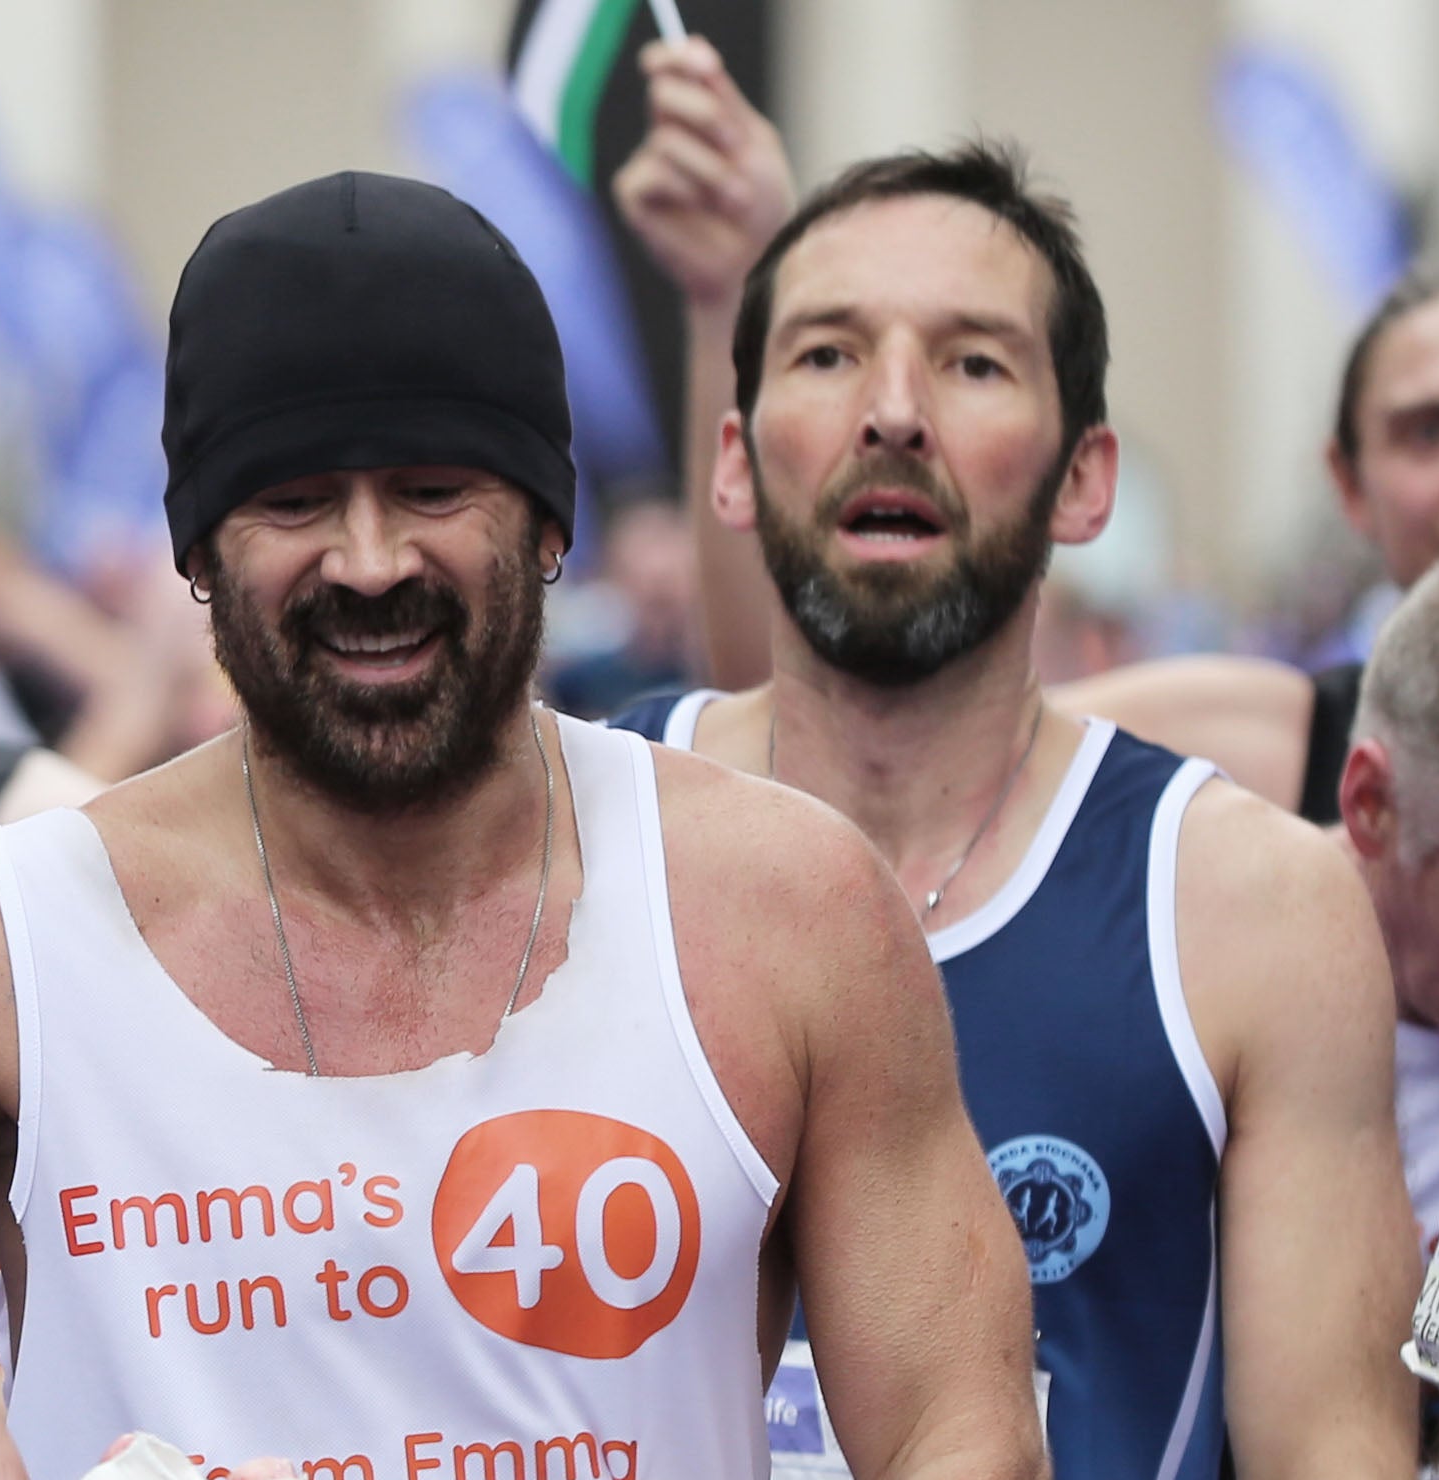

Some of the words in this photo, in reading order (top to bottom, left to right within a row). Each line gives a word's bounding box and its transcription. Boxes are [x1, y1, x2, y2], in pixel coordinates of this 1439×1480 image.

[58, 1162, 405, 1256] Emma's
[451, 1156, 684, 1311] 40
[144, 1276, 288, 1338] run
[315, 1259, 410, 1324] to
[765, 1396, 799, 1427] ife
